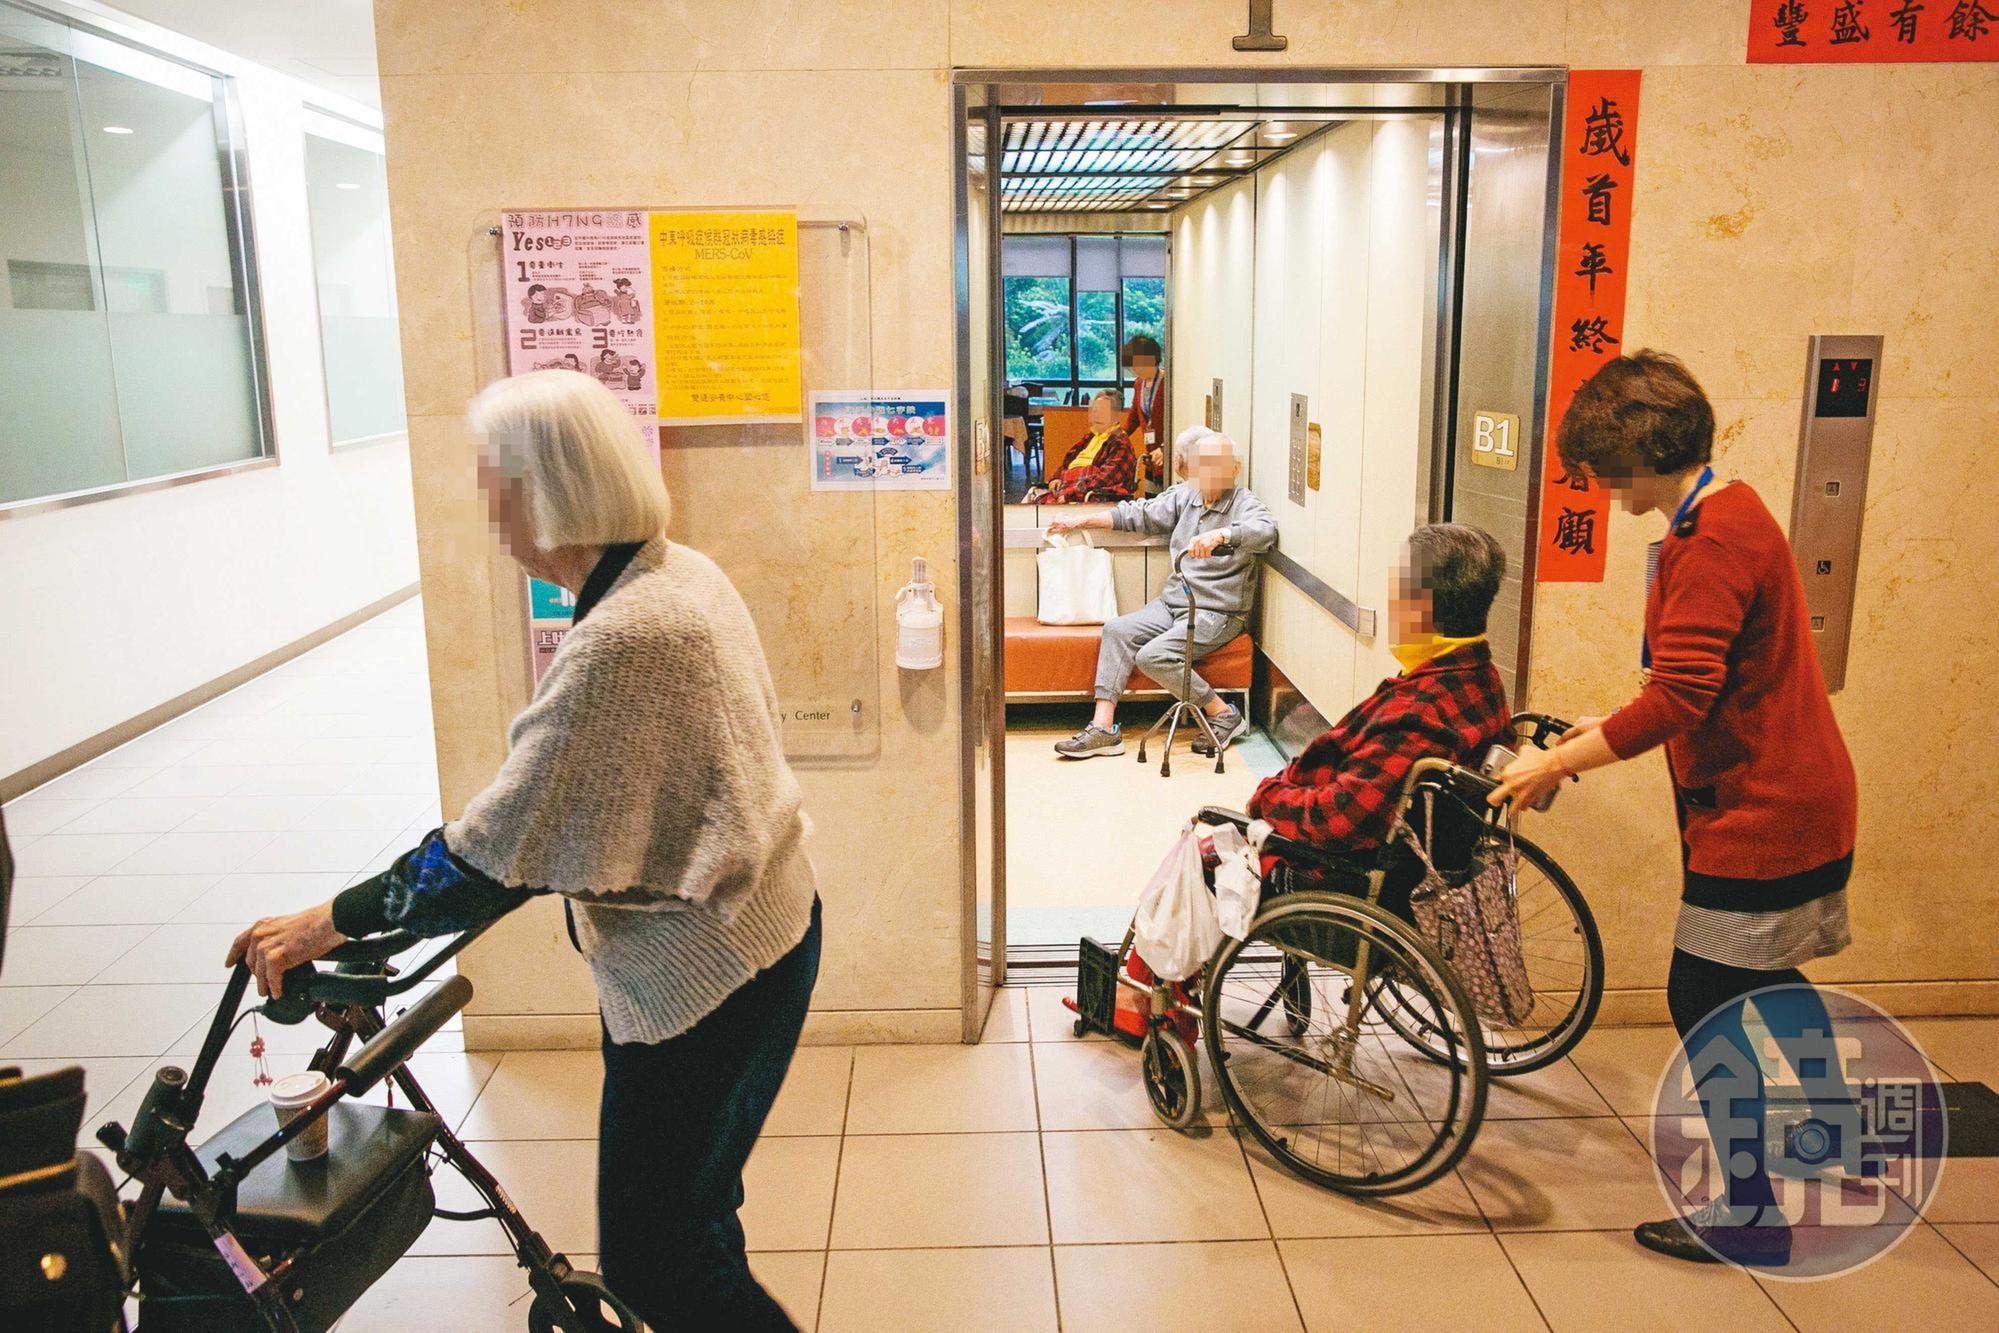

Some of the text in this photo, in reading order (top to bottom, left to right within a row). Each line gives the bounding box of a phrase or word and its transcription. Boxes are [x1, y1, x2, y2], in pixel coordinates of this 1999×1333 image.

[512, 231, 544, 251] Yes
[694, 248, 753, 260] MERS-CoV
[516, 261, 530, 283] 1
[1552, 96, 1631, 555] 歲首年終顧
[519, 329, 537, 350] 2
[592, 328, 608, 349] 3
[1474, 415, 1514, 457] B1
[795, 711, 830, 721] Center
